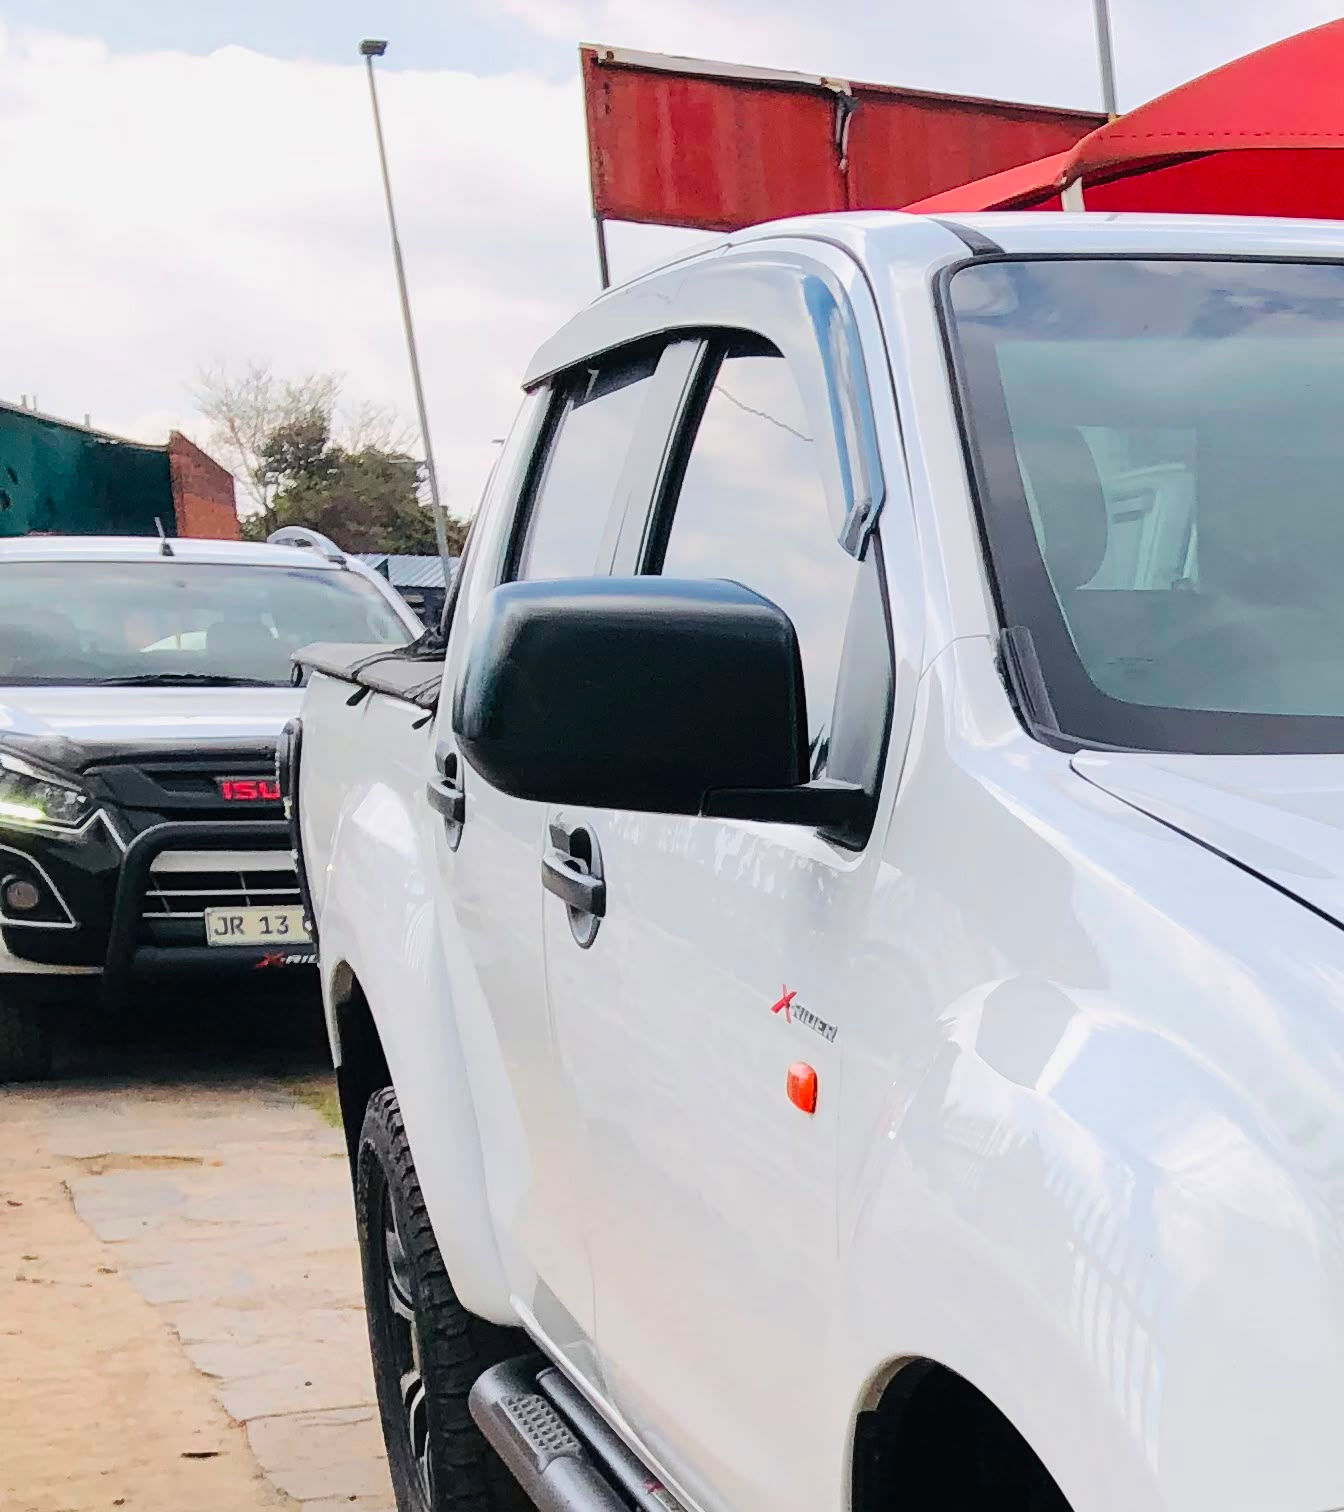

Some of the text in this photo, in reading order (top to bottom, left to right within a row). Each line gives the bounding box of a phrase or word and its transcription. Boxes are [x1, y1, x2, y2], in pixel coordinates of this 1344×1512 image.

[222, 780, 280, 801] ISU
[214, 916, 245, 936] JR
[259, 915, 289, 935] 13
